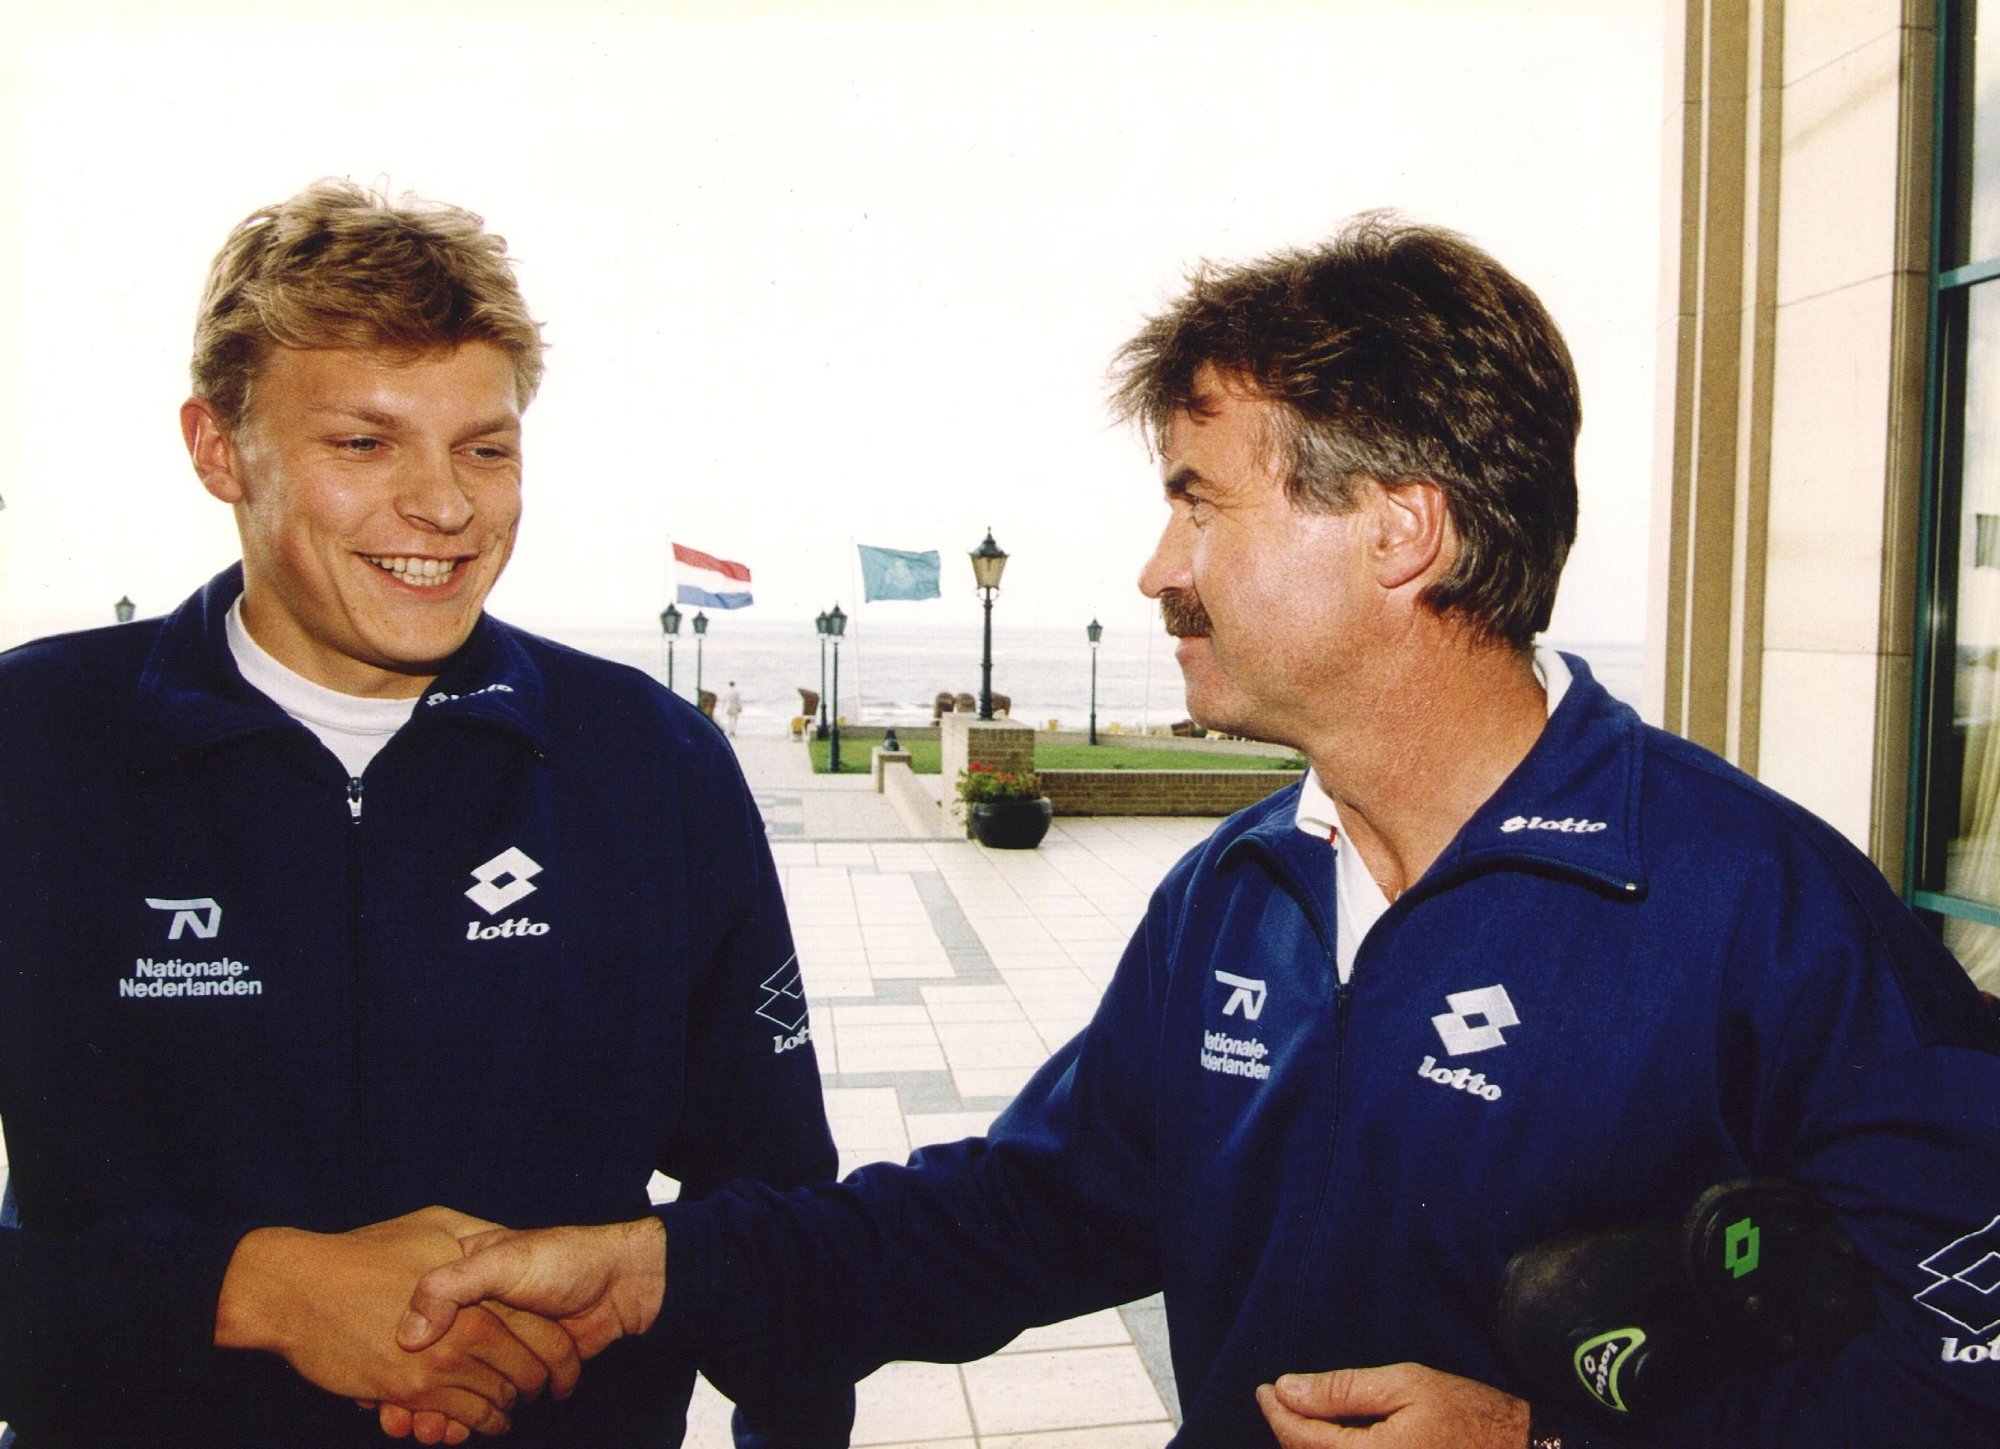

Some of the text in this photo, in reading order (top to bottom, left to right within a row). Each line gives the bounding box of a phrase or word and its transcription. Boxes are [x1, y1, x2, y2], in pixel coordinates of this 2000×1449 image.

[1527, 816, 1607, 833] lotto
[466, 917, 551, 941] lotto
[136, 957, 250, 978] Nationale-
[119, 976, 263, 998] Nederlanden
[773, 1026, 809, 1054] lot
[1417, 1055, 1502, 1101] lotto
[1940, 1333, 2000, 1363] lot
[1596, 1341, 1619, 1395] lotto
